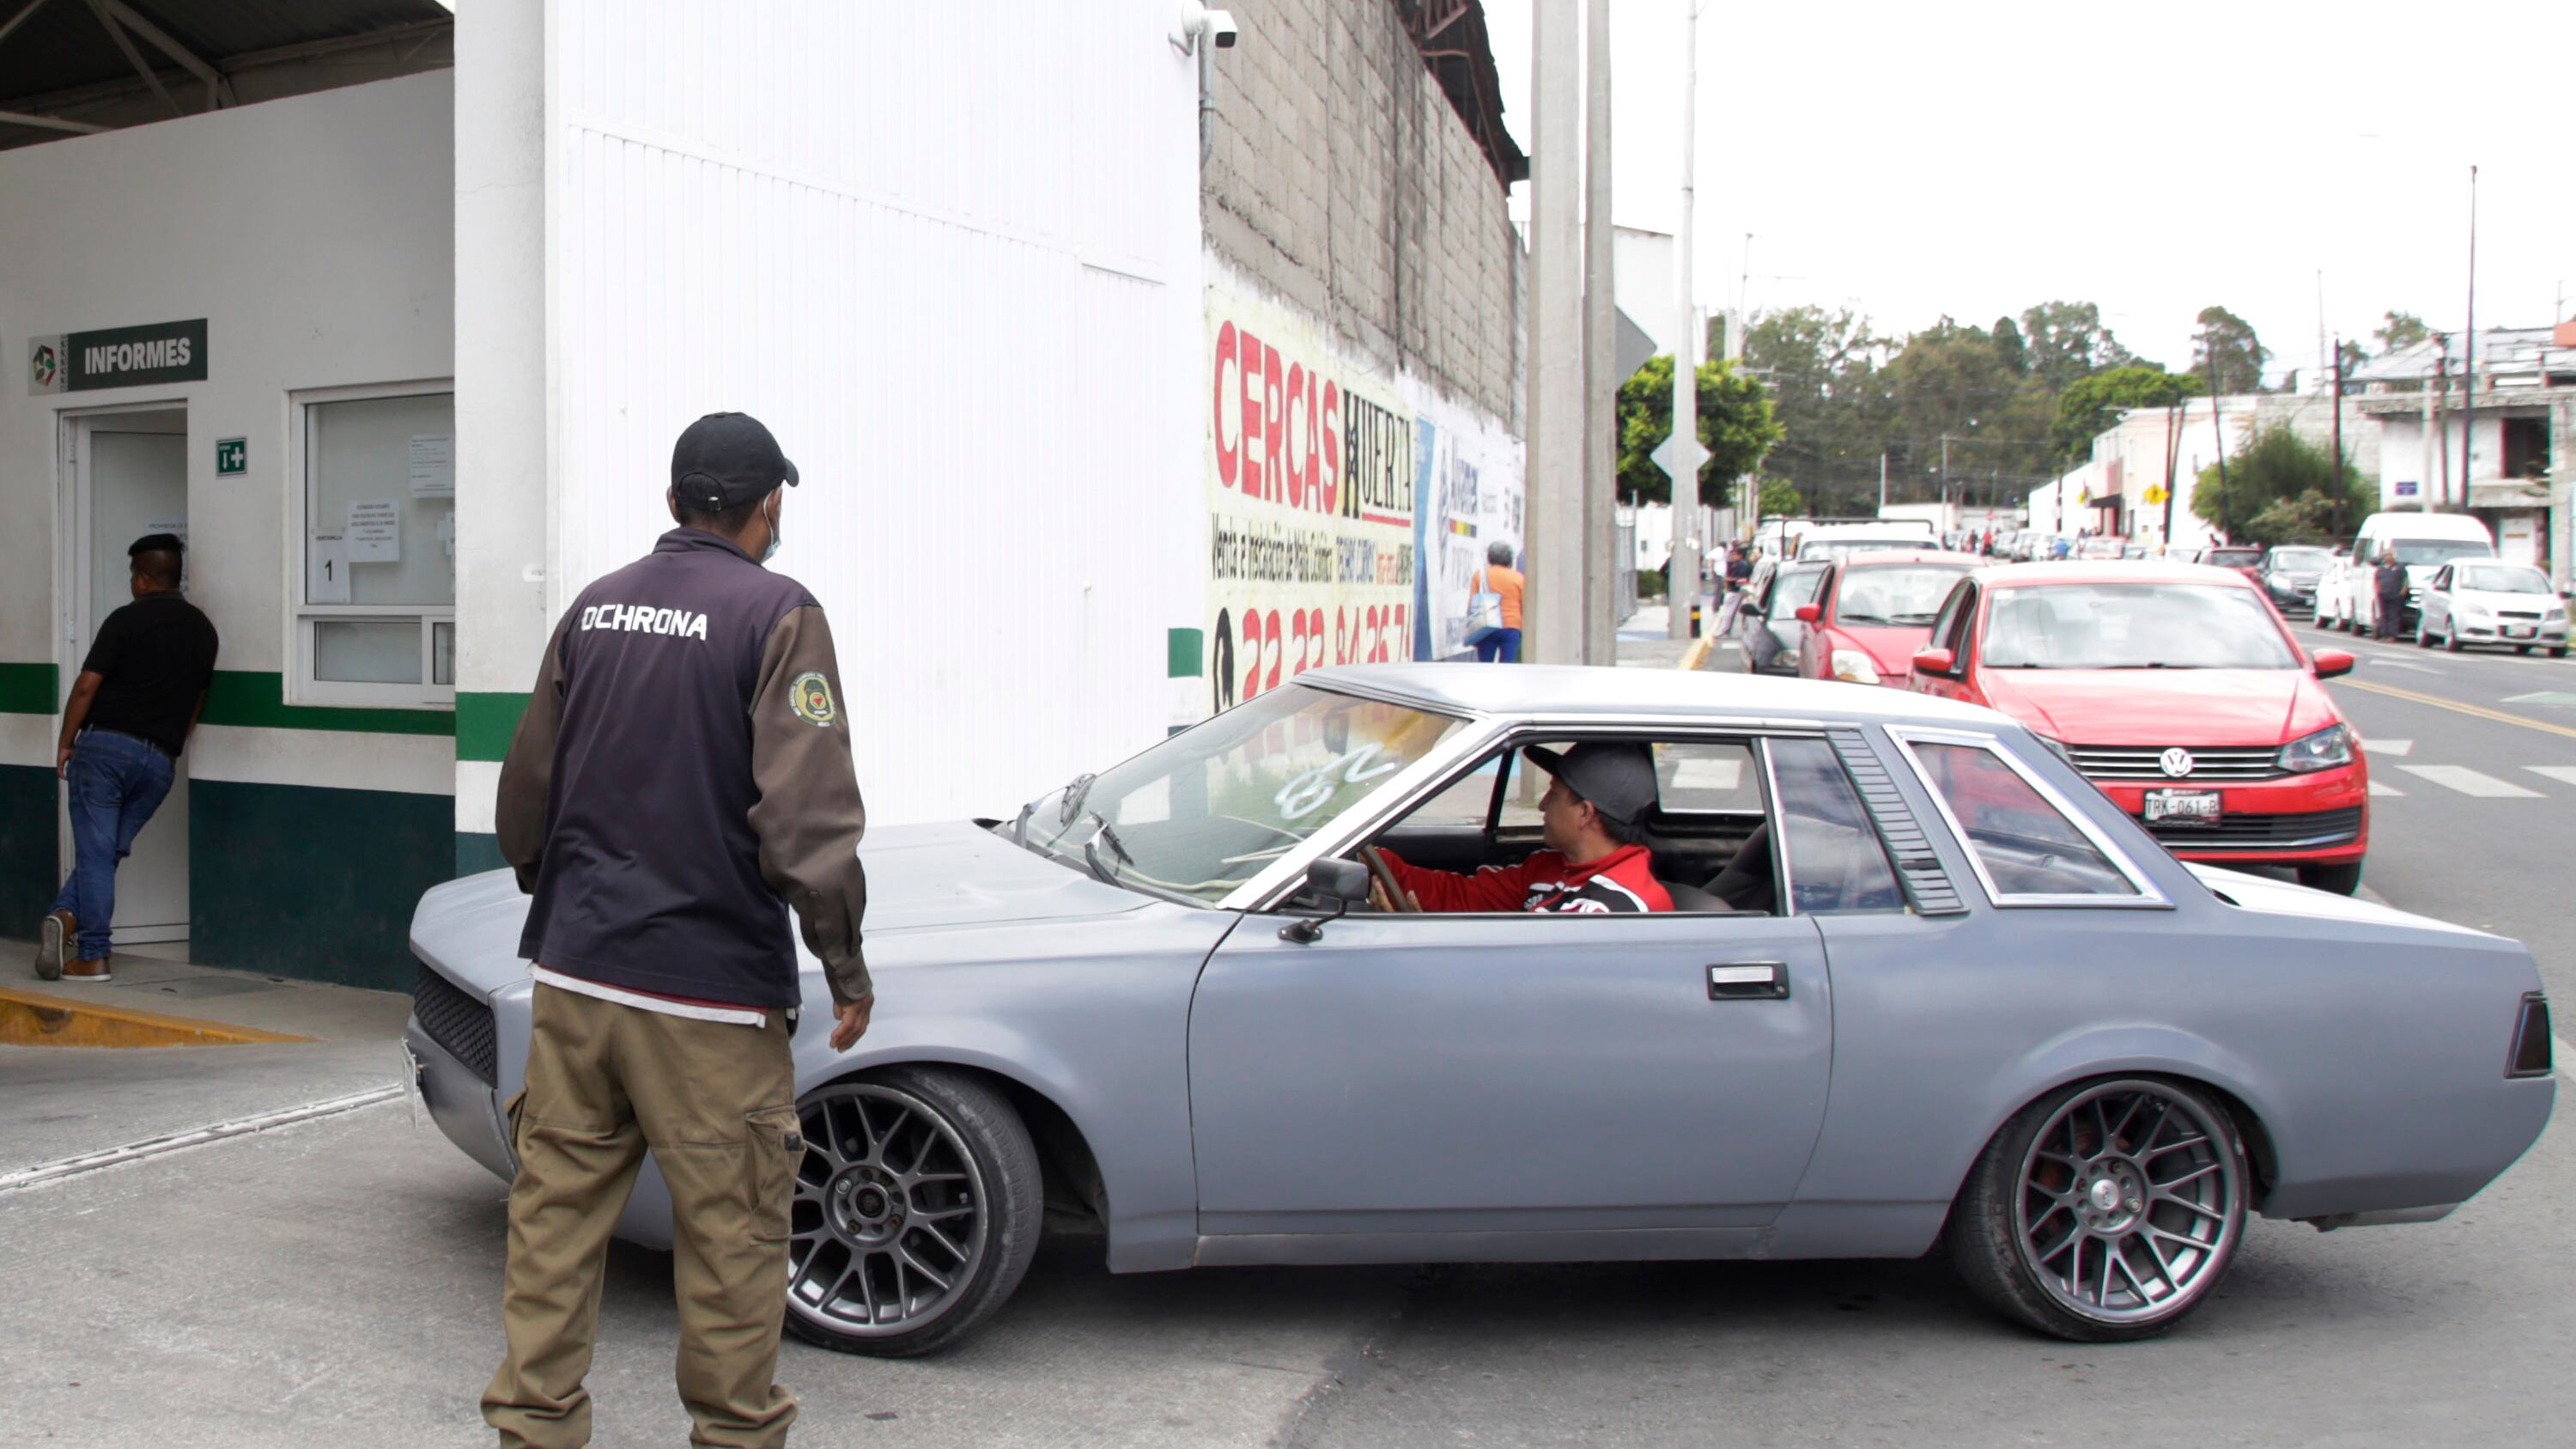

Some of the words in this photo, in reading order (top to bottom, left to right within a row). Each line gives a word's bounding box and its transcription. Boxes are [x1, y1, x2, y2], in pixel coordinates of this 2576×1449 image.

[84, 338, 191, 375] INFORMES
[1214, 320, 1338, 515] CERCAS
[1343, 388, 1411, 520] HUERTA
[1212, 512, 1236, 581] Venta
[325, 559, 332, 581] 1
[580, 603, 708, 641] OCHRONA
